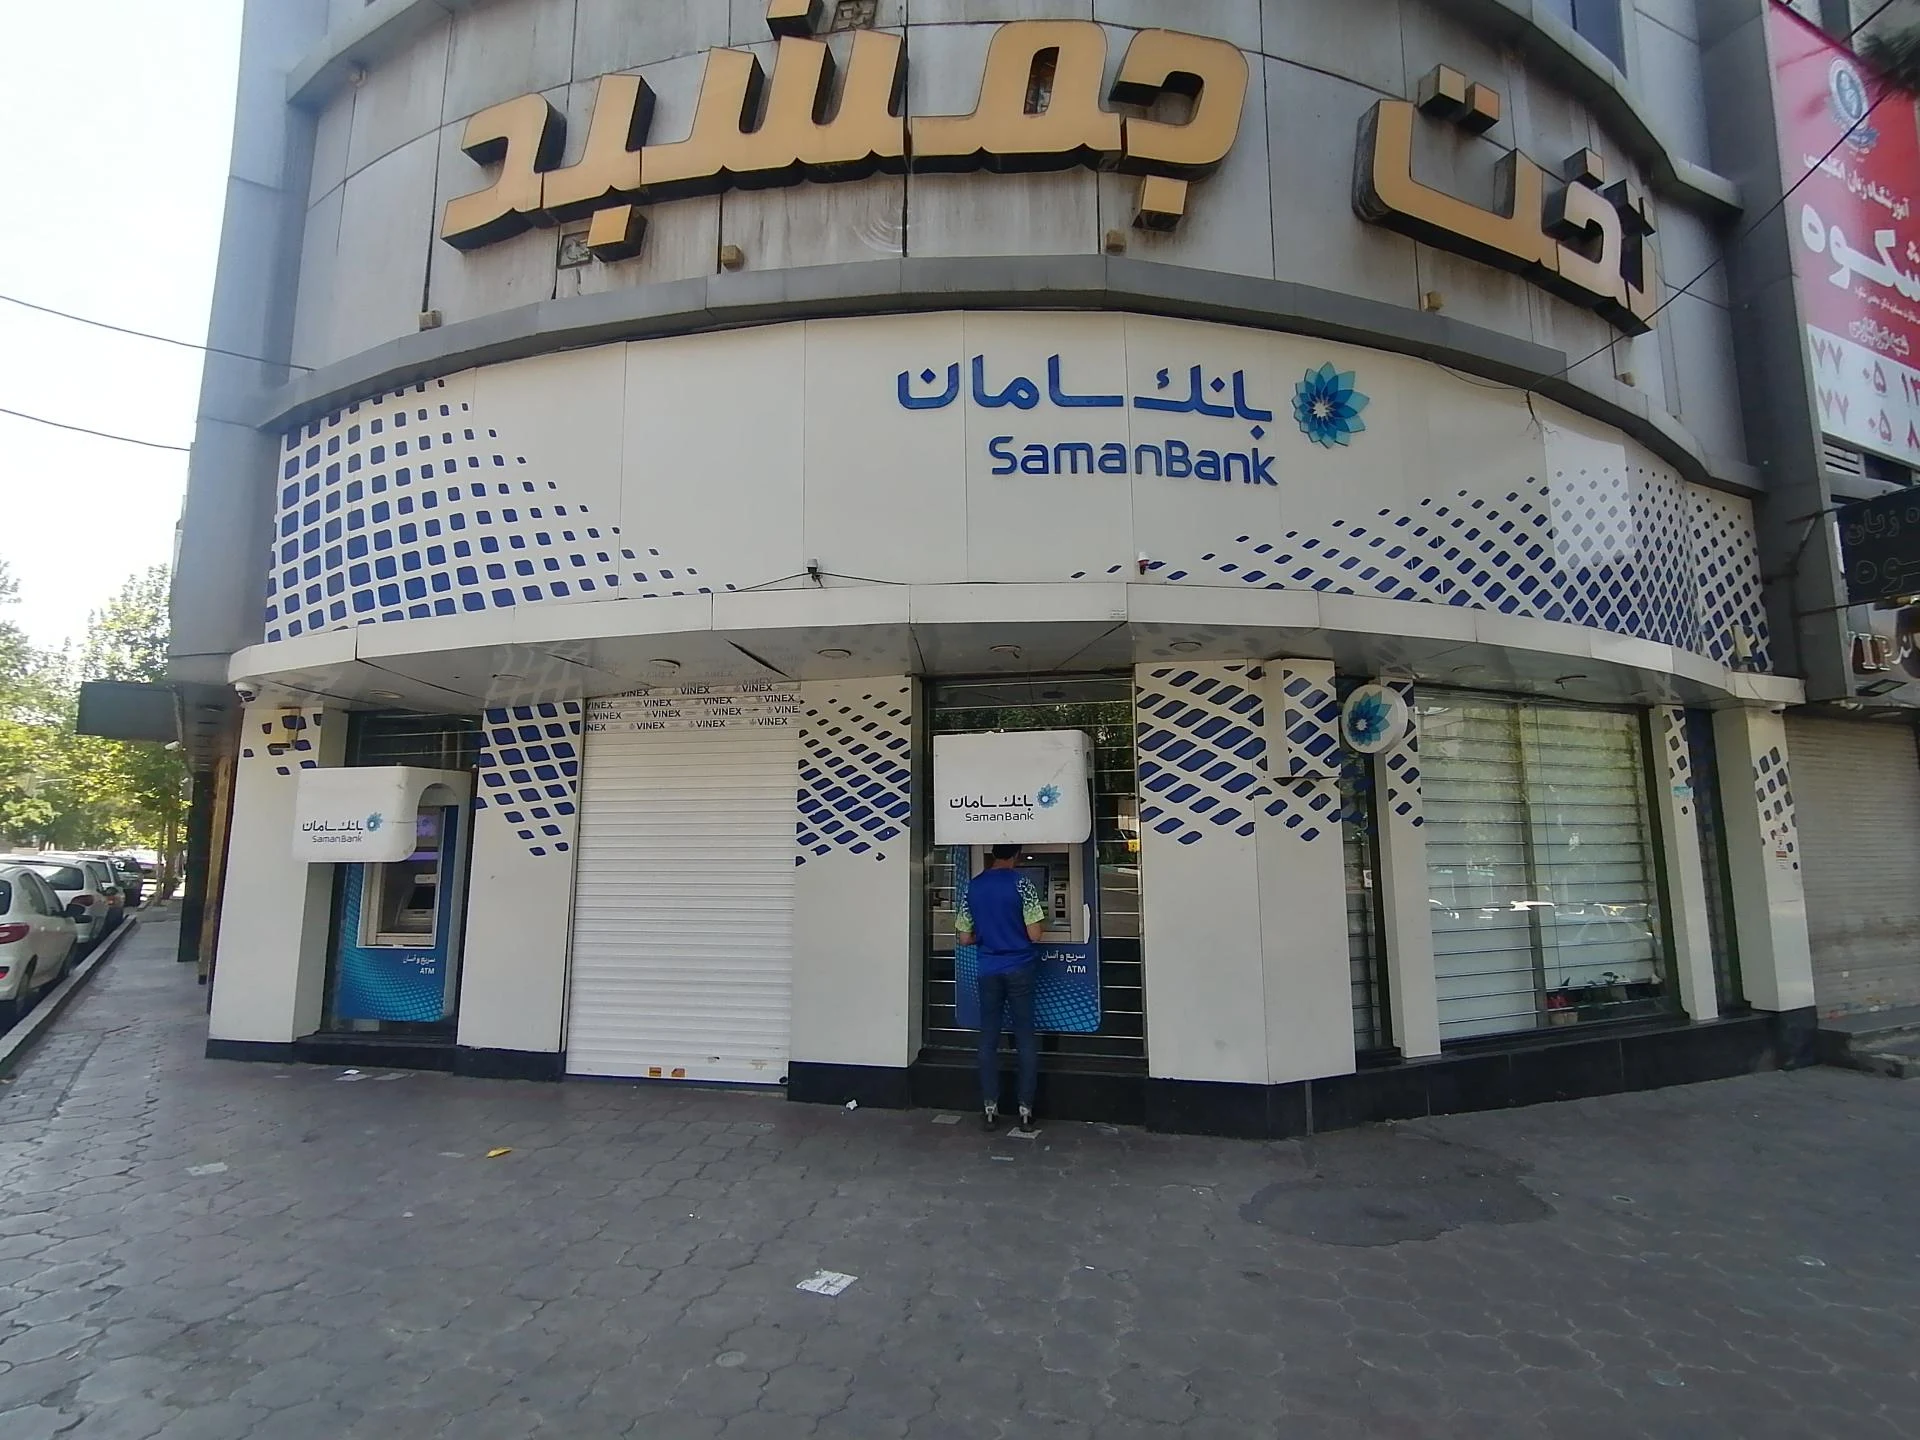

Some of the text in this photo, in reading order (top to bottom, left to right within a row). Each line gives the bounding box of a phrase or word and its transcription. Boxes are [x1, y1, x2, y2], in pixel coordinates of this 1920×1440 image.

[897, 353, 1125, 410] سامان
[988, 435, 1278, 487] SamanBank
[680, 687, 710, 695] VINEX
[742, 683, 773, 692] VINEX
[643, 699, 672, 707] VINEX
[703, 697, 732, 705] VINEX
[764, 694, 795, 702] VINEX
[593, 705, 800, 720] VINEX VINEX VINEX VINE
[636, 721, 665, 730] VINEX
[696, 719, 726, 728] VINEX
[757, 717, 788, 726] VINEX
[949, 795, 997, 809] سامان
[302, 819, 337, 832] سامان
[419, 967, 435, 975] ATM
[1066, 965, 1086, 974] ATM
